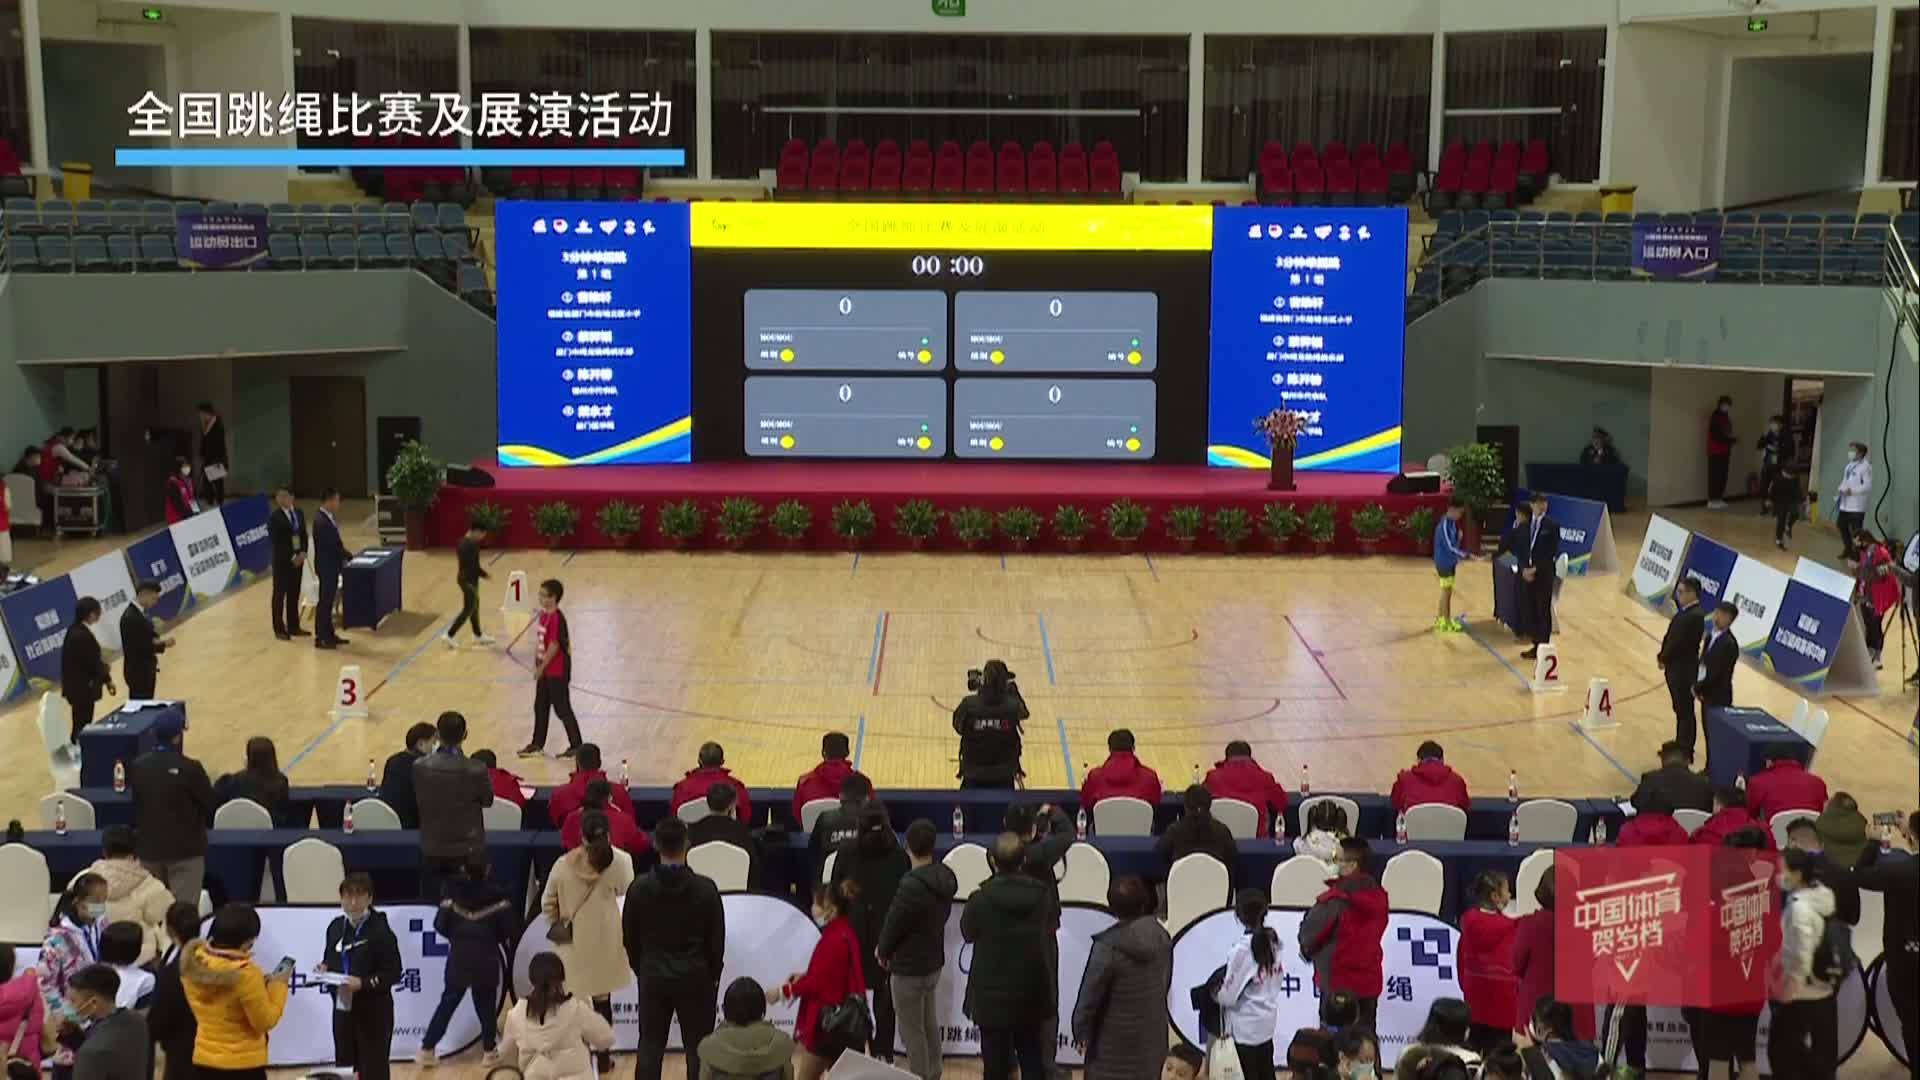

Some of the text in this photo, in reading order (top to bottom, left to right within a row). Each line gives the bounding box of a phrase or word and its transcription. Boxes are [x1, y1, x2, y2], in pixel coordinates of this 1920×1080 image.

[839, 297, 852, 315] 0
[1049, 299, 1063, 317] 0
[839, 384, 852, 402] 0
[1048, 386, 1062, 404] 0
[510, 579, 521, 601] 1
[1544, 655, 1559, 681] 2
[341, 678, 357, 706] 3
[1598, 688, 1612, 717] 4
